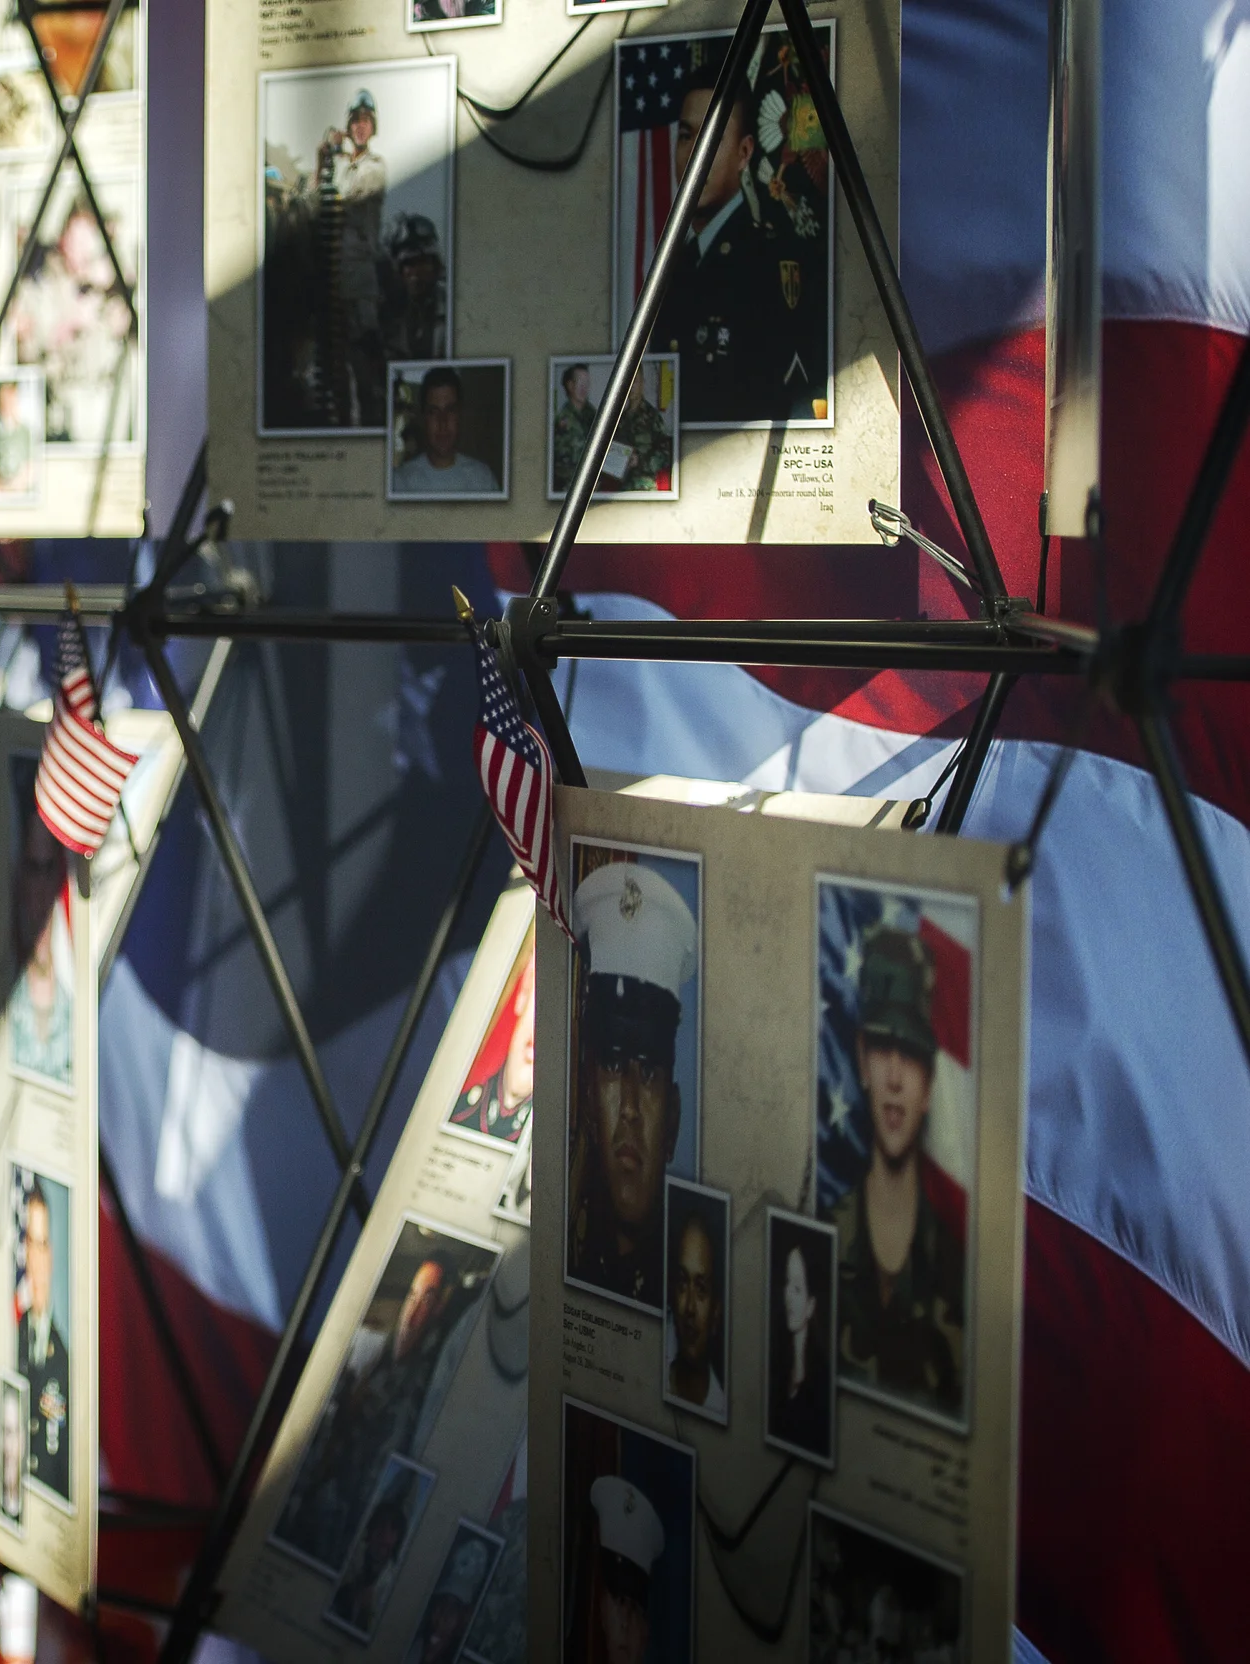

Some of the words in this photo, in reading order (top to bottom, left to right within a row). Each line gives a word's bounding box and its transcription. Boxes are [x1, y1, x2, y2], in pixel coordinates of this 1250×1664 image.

[821, 445, 834, 454] 22
[783, 460, 803, 469] SPC
[813, 460, 834, 469] USA
[821, 473, 834, 483] CA
[717, 488, 733, 499] June
[796, 488, 816, 497] round
[818, 488, 834, 497] blast
[820, 502, 834, 514] Iraq
